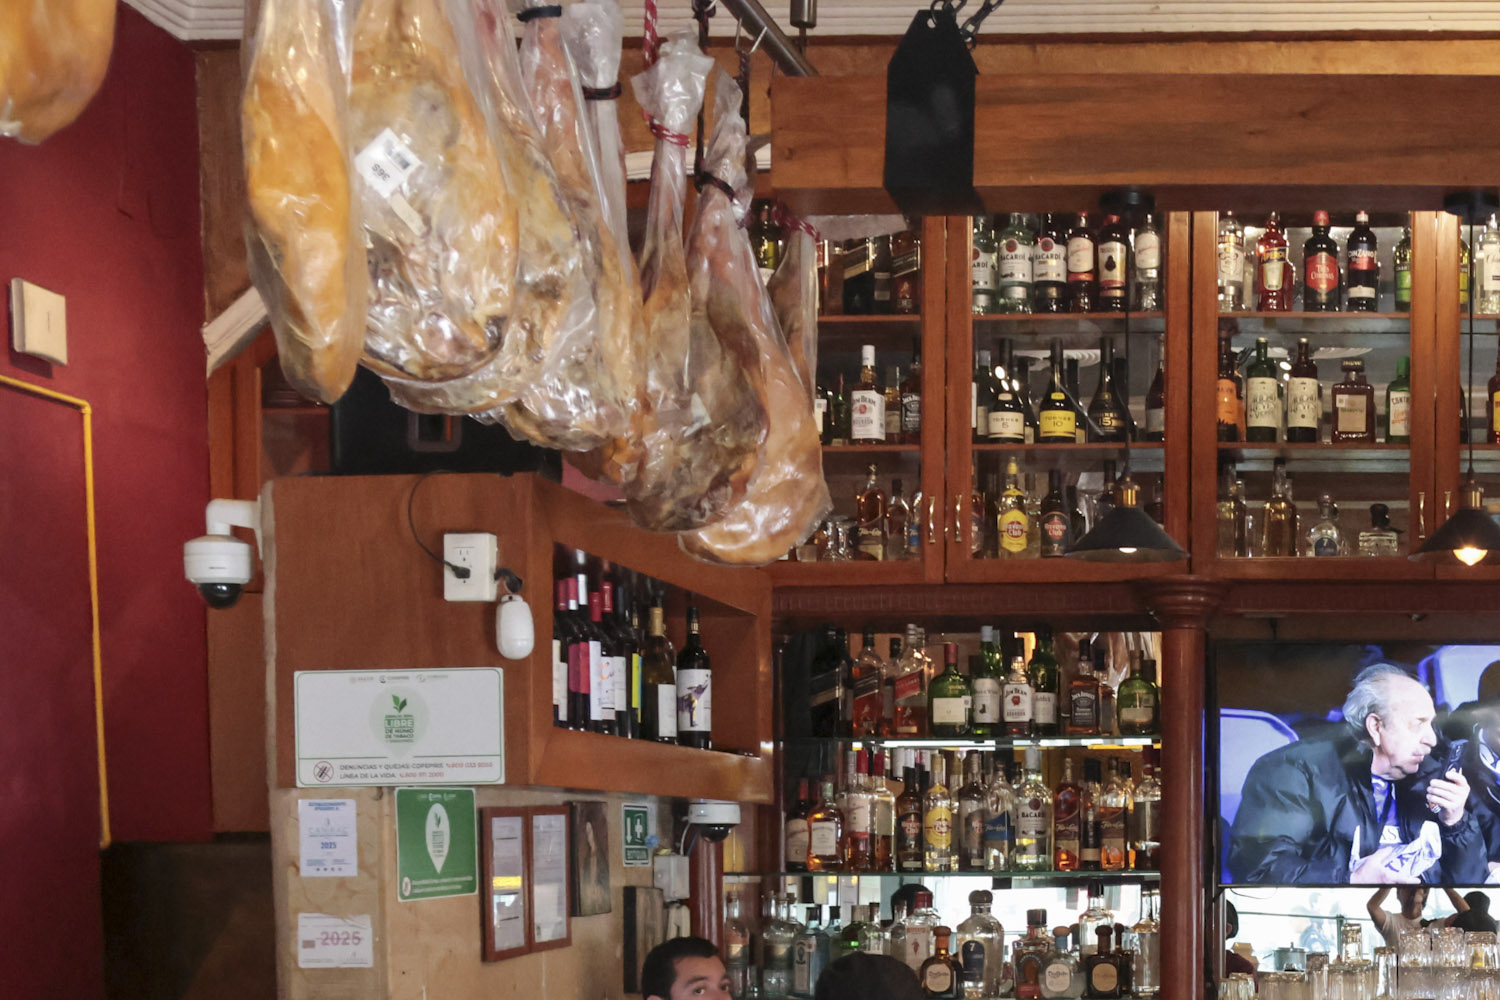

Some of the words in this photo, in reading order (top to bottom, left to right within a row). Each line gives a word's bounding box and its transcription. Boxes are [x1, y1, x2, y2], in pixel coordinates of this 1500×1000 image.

[1053, 544, 1058, 552] 7
[384, 720, 414, 728] LIBRE
[970, 943, 974, 951] 7
